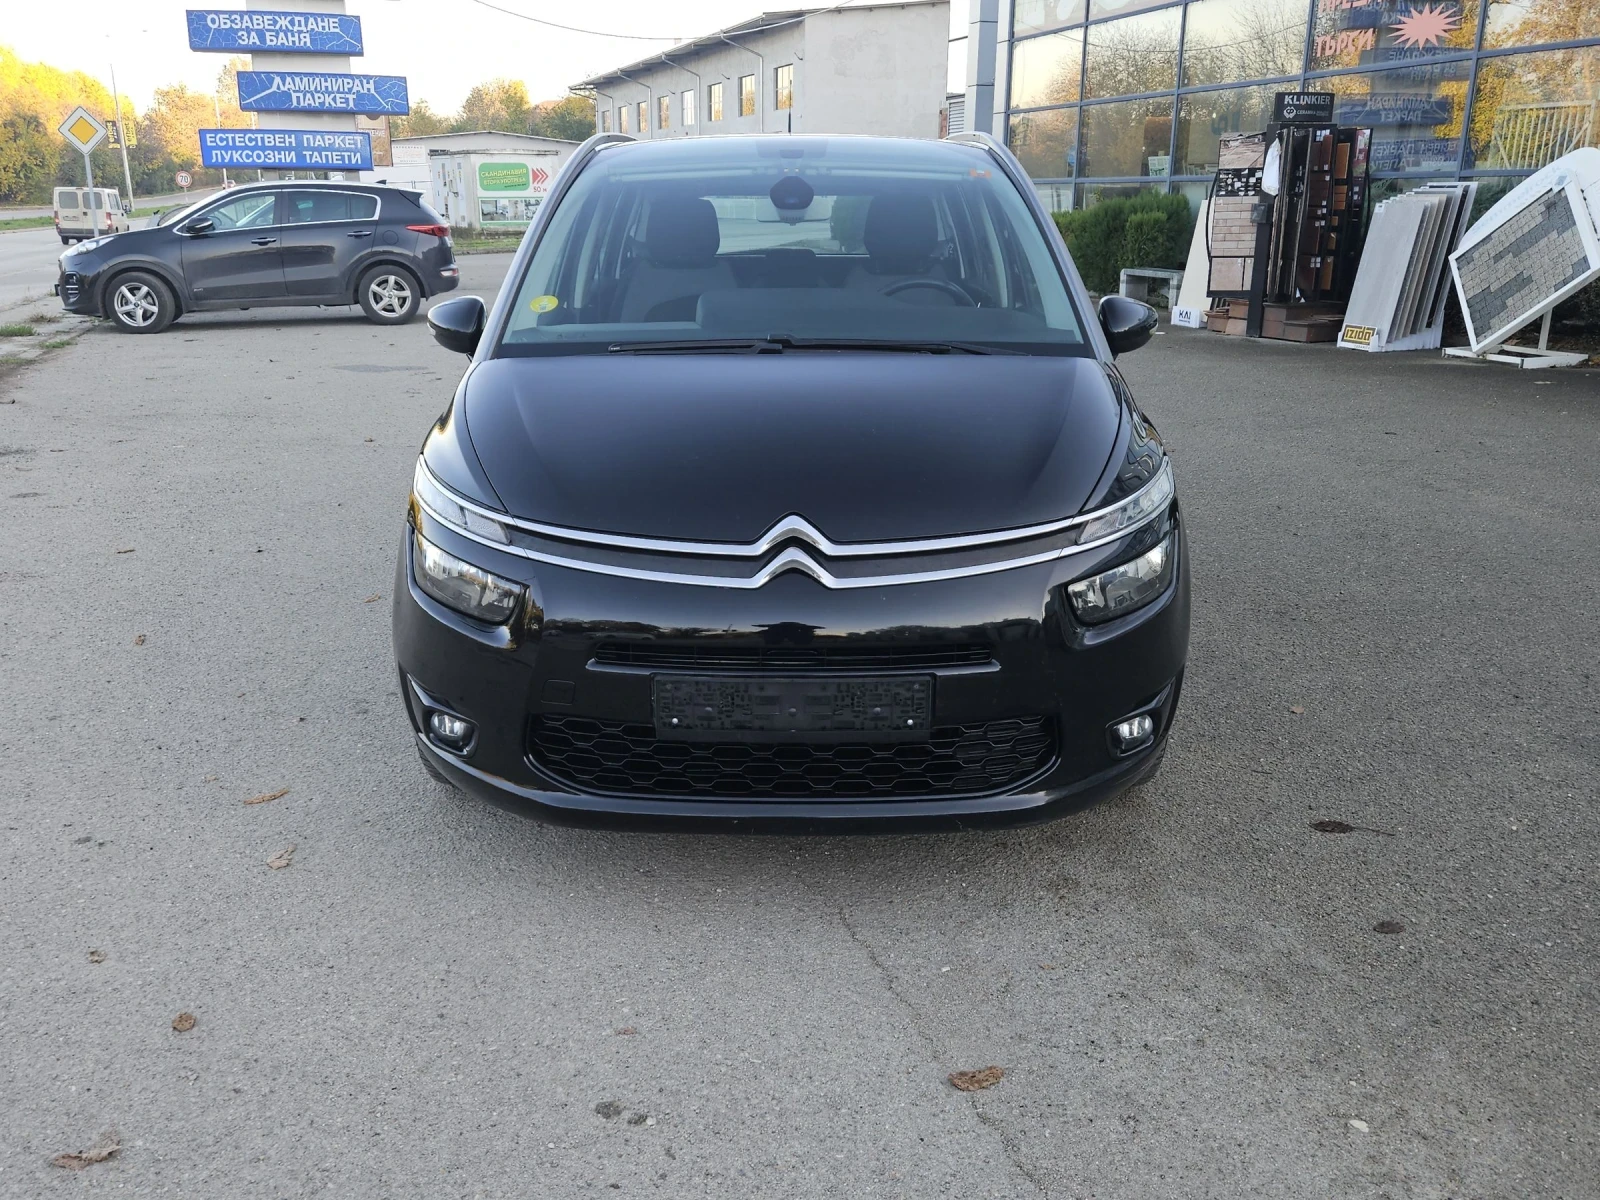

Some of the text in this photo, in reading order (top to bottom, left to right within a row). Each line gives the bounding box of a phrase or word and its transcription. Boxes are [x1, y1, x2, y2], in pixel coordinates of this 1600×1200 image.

[206, 13, 340, 32] ОБЗАВЕЖДАНЕ
[237, 31, 312, 47] ЗА БАНЯ
[270, 75, 376, 95] ЛАМИНИРАН
[290, 92, 357, 109] ПАРКЕТ
[1284, 94, 1331, 105] KLINKIER
[205, 133, 364, 149] ЕСТЕСТВЕН ПАРКЕТ
[211, 149, 362, 165] ЛУКСОЗНИ ТАПЕТИ
[179, 175, 189, 183] 70
[481, 169, 527, 177] СКАНДИНАВИЯ
[1178, 309, 1192, 320] KAI
